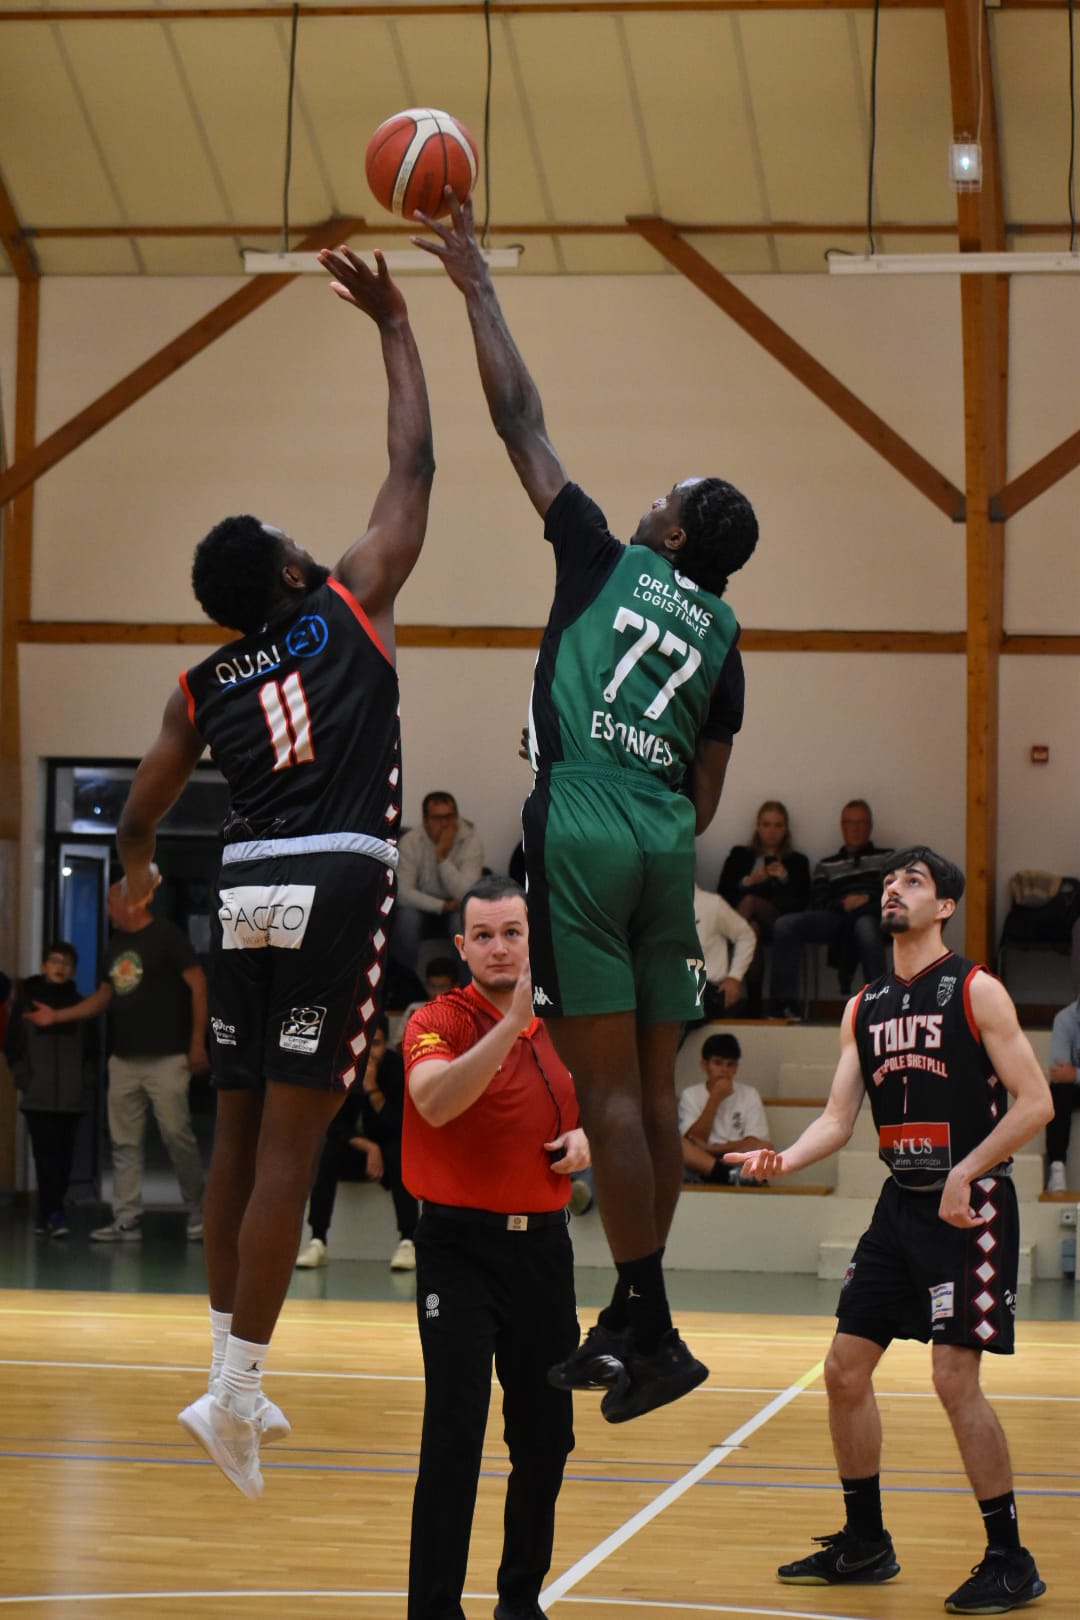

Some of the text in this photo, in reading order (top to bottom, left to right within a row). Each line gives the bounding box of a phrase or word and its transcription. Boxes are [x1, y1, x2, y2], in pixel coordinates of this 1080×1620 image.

[633, 587, 708, 640] LOGISTIQUE
[638, 573, 714, 628] ORLEANS
[215, 644, 281, 685] QUAI
[603, 606, 702, 721] 77
[258, 670, 315, 772] 11
